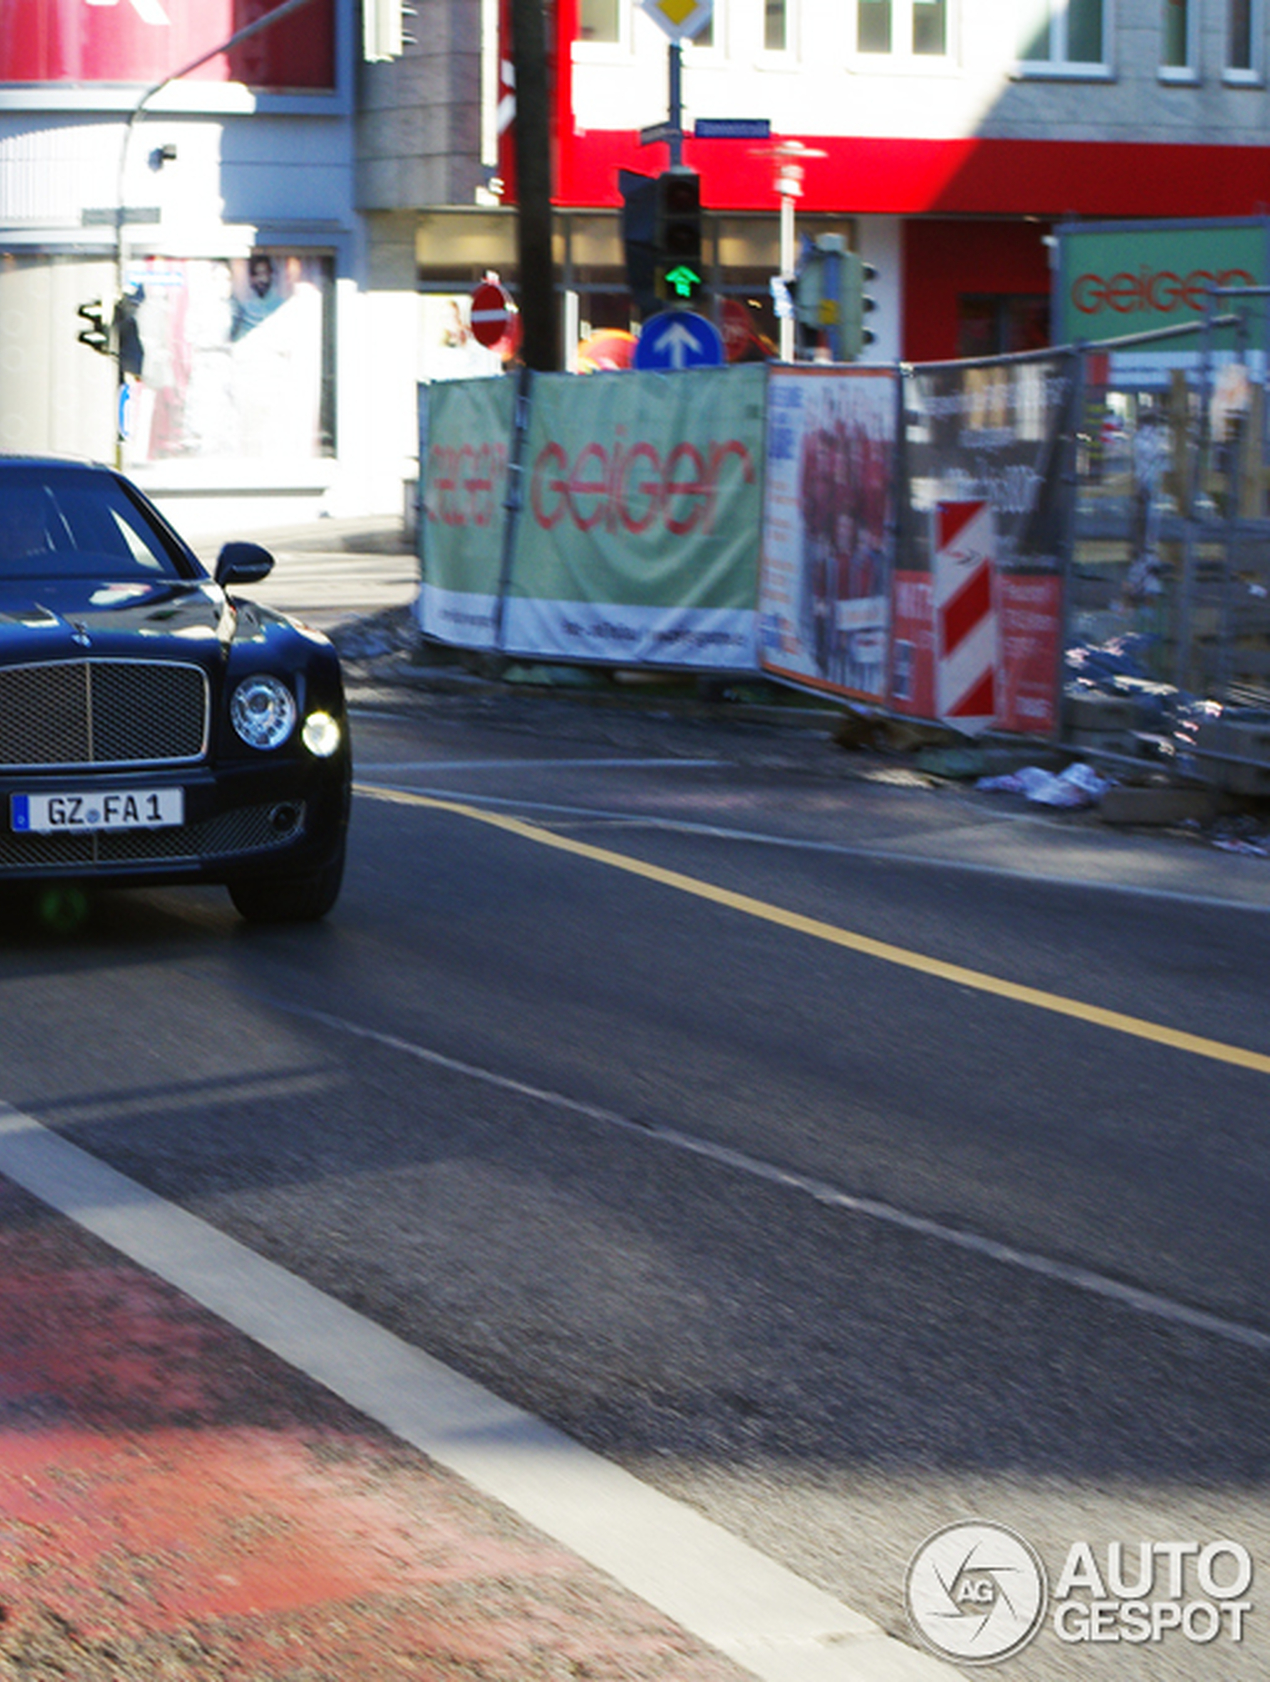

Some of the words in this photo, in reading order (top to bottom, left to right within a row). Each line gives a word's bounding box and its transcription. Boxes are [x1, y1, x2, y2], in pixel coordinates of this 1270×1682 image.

[48, 797, 84, 825] GZ
[103, 795, 139, 823] FA
[146, 793, 163, 821] 1
